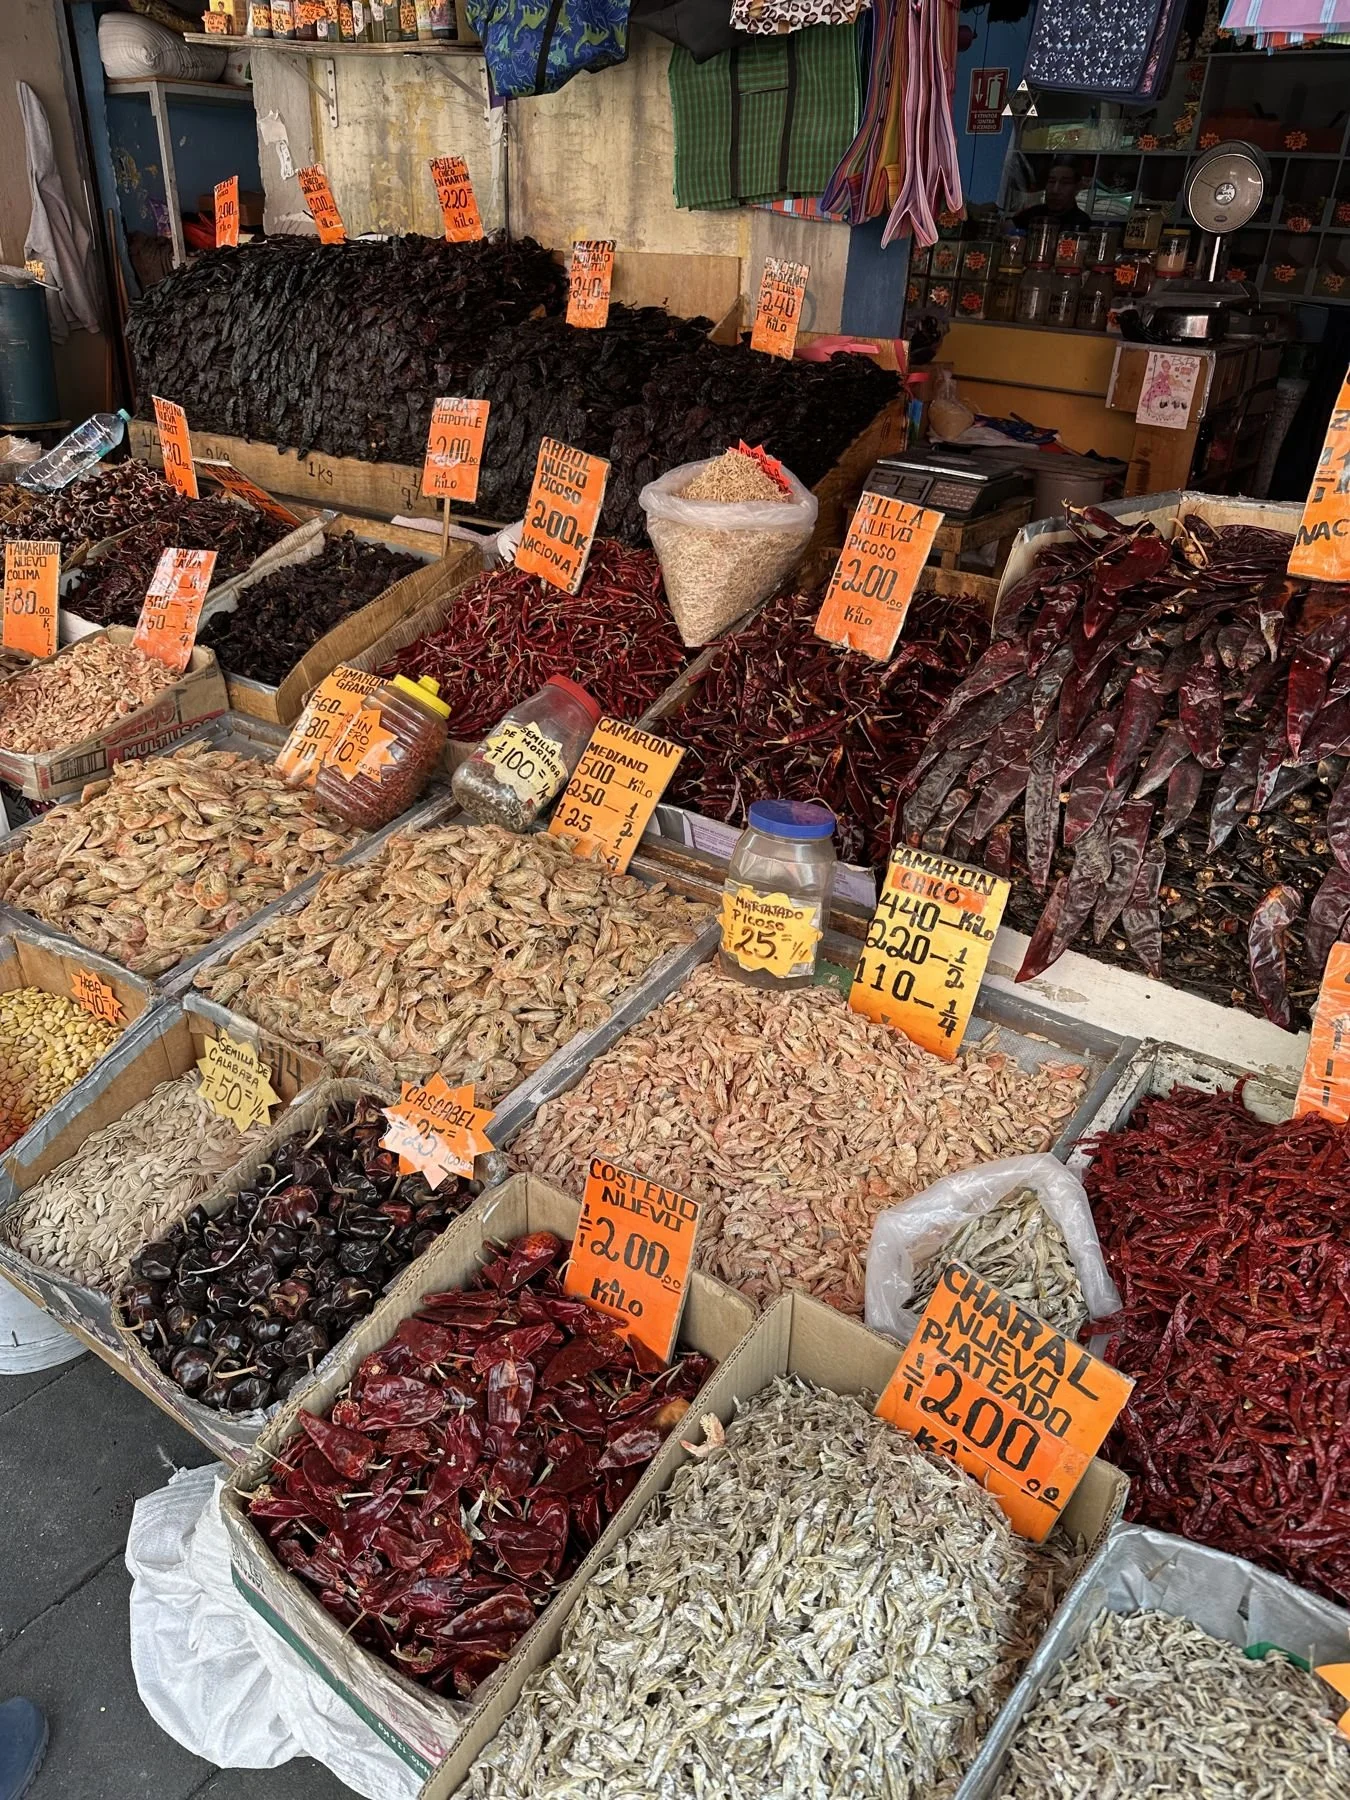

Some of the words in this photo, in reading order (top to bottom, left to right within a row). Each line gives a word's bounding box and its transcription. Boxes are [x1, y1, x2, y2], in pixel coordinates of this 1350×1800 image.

[429, 156, 465, 172] PASILLA
[431, 413, 483, 429] CHIPOTLE
[540, 438, 591, 473] ARBOL
[538, 472, 582, 505] PICOSO
[540, 456, 588, 489] NUEVO
[858, 517, 915, 543] NUEVO
[8, 542, 59, 556] TAMARINDO
[13, 556, 47, 569] NUEVO
[848, 534, 897, 562] PICOSO
[6, 569, 40, 582] COLIMA
[331, 666, 390, 687] CAMARON
[309, 694, 342, 714] 560
[124, 718, 213, 761] MULTIUSO
[503, 729, 517, 739] DE
[521, 738, 560, 778] MORINGA
[520, 727, 557, 758] SEMILLA
[598, 718, 675, 758] CAMARON
[577, 756, 616, 785] 500
[586, 742, 649, 774] MEDIANO
[566, 779, 606, 807] 250
[555, 803, 593, 833] 125
[892, 848, 998, 896] CAMARON
[900, 871, 961, 904] CHICO
[732, 908, 786, 932] PICOSO
[879, 892, 941, 933] 440
[865, 918, 931, 965] 220
[81, 976, 103, 995] HABA
[853, 957, 916, 1002] 110
[209, 1047, 259, 1088] CALABAZA
[218, 1037, 254, 1068] SEMILLA
[255, 1062, 269, 1078] DE
[404, 1085, 476, 1131] CASCABEL
[602, 1185, 684, 1233] NUEVO
[943, 1262, 1100, 1401] CHARAL
[945, 1301, 1061, 1399] NUEVO
[919, 1318, 1073, 1438] PLATEADO
